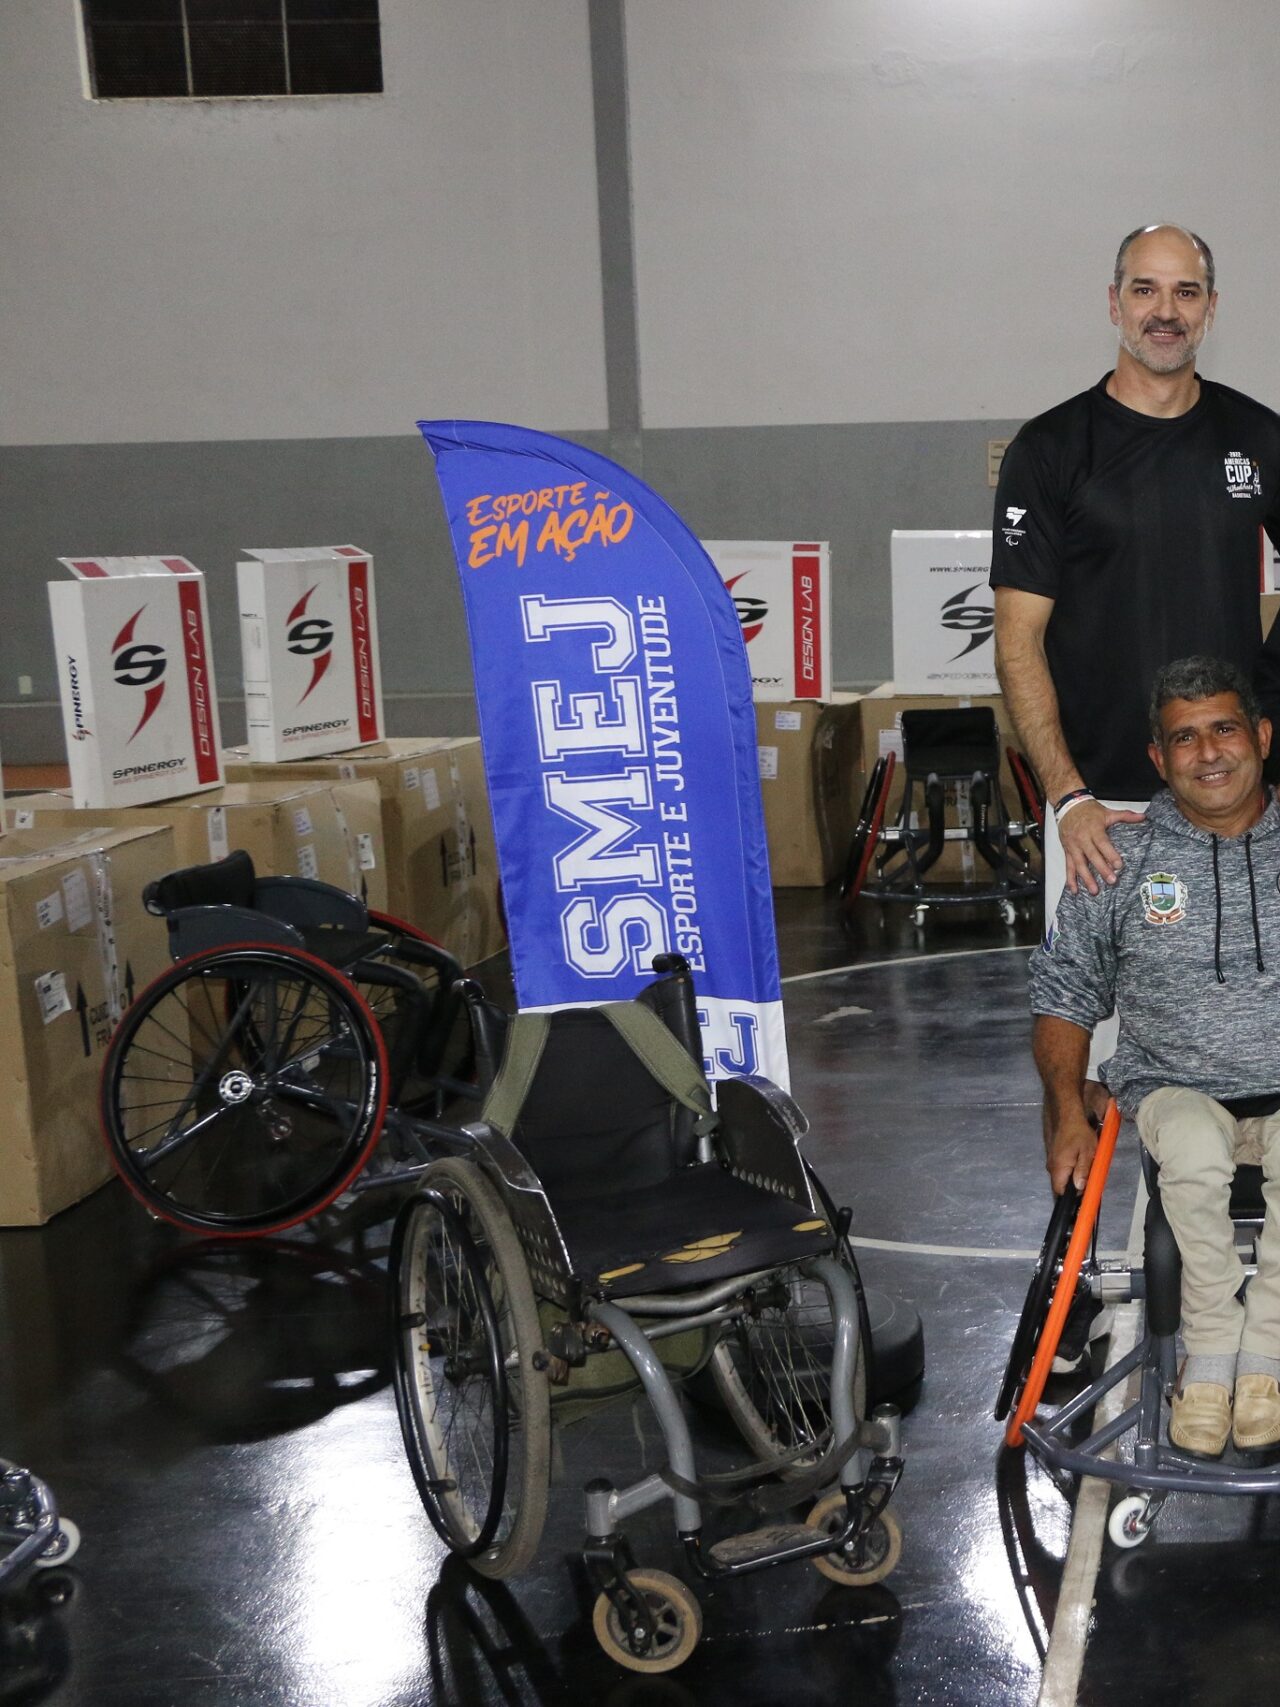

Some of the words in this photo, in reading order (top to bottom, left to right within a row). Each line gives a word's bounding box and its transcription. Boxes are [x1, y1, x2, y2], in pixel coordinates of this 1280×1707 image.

[1225, 465, 1252, 483] CUP
[466, 481, 588, 527] ESPORTE
[467, 524, 529, 569] EM
[536, 491, 634, 562] AÇÃO
[354, 586, 366, 632] LAB
[801, 575, 813, 612] LAB
[186, 609, 201, 659] LAB
[802, 615, 814, 681] DESIGN
[68, 654, 86, 741] SPINERGY
[359, 636, 372, 718] DESIGN
[637, 594, 687, 792] JUVENTUDE
[193, 666, 211, 757] DESIGN
[282, 718, 351, 737] SPINERGY
[112, 757, 187, 779] SPINERGY
[519, 594, 672, 980] SMEJ
[660, 802, 689, 823] E
[664, 831, 707, 974] ESPORTE
